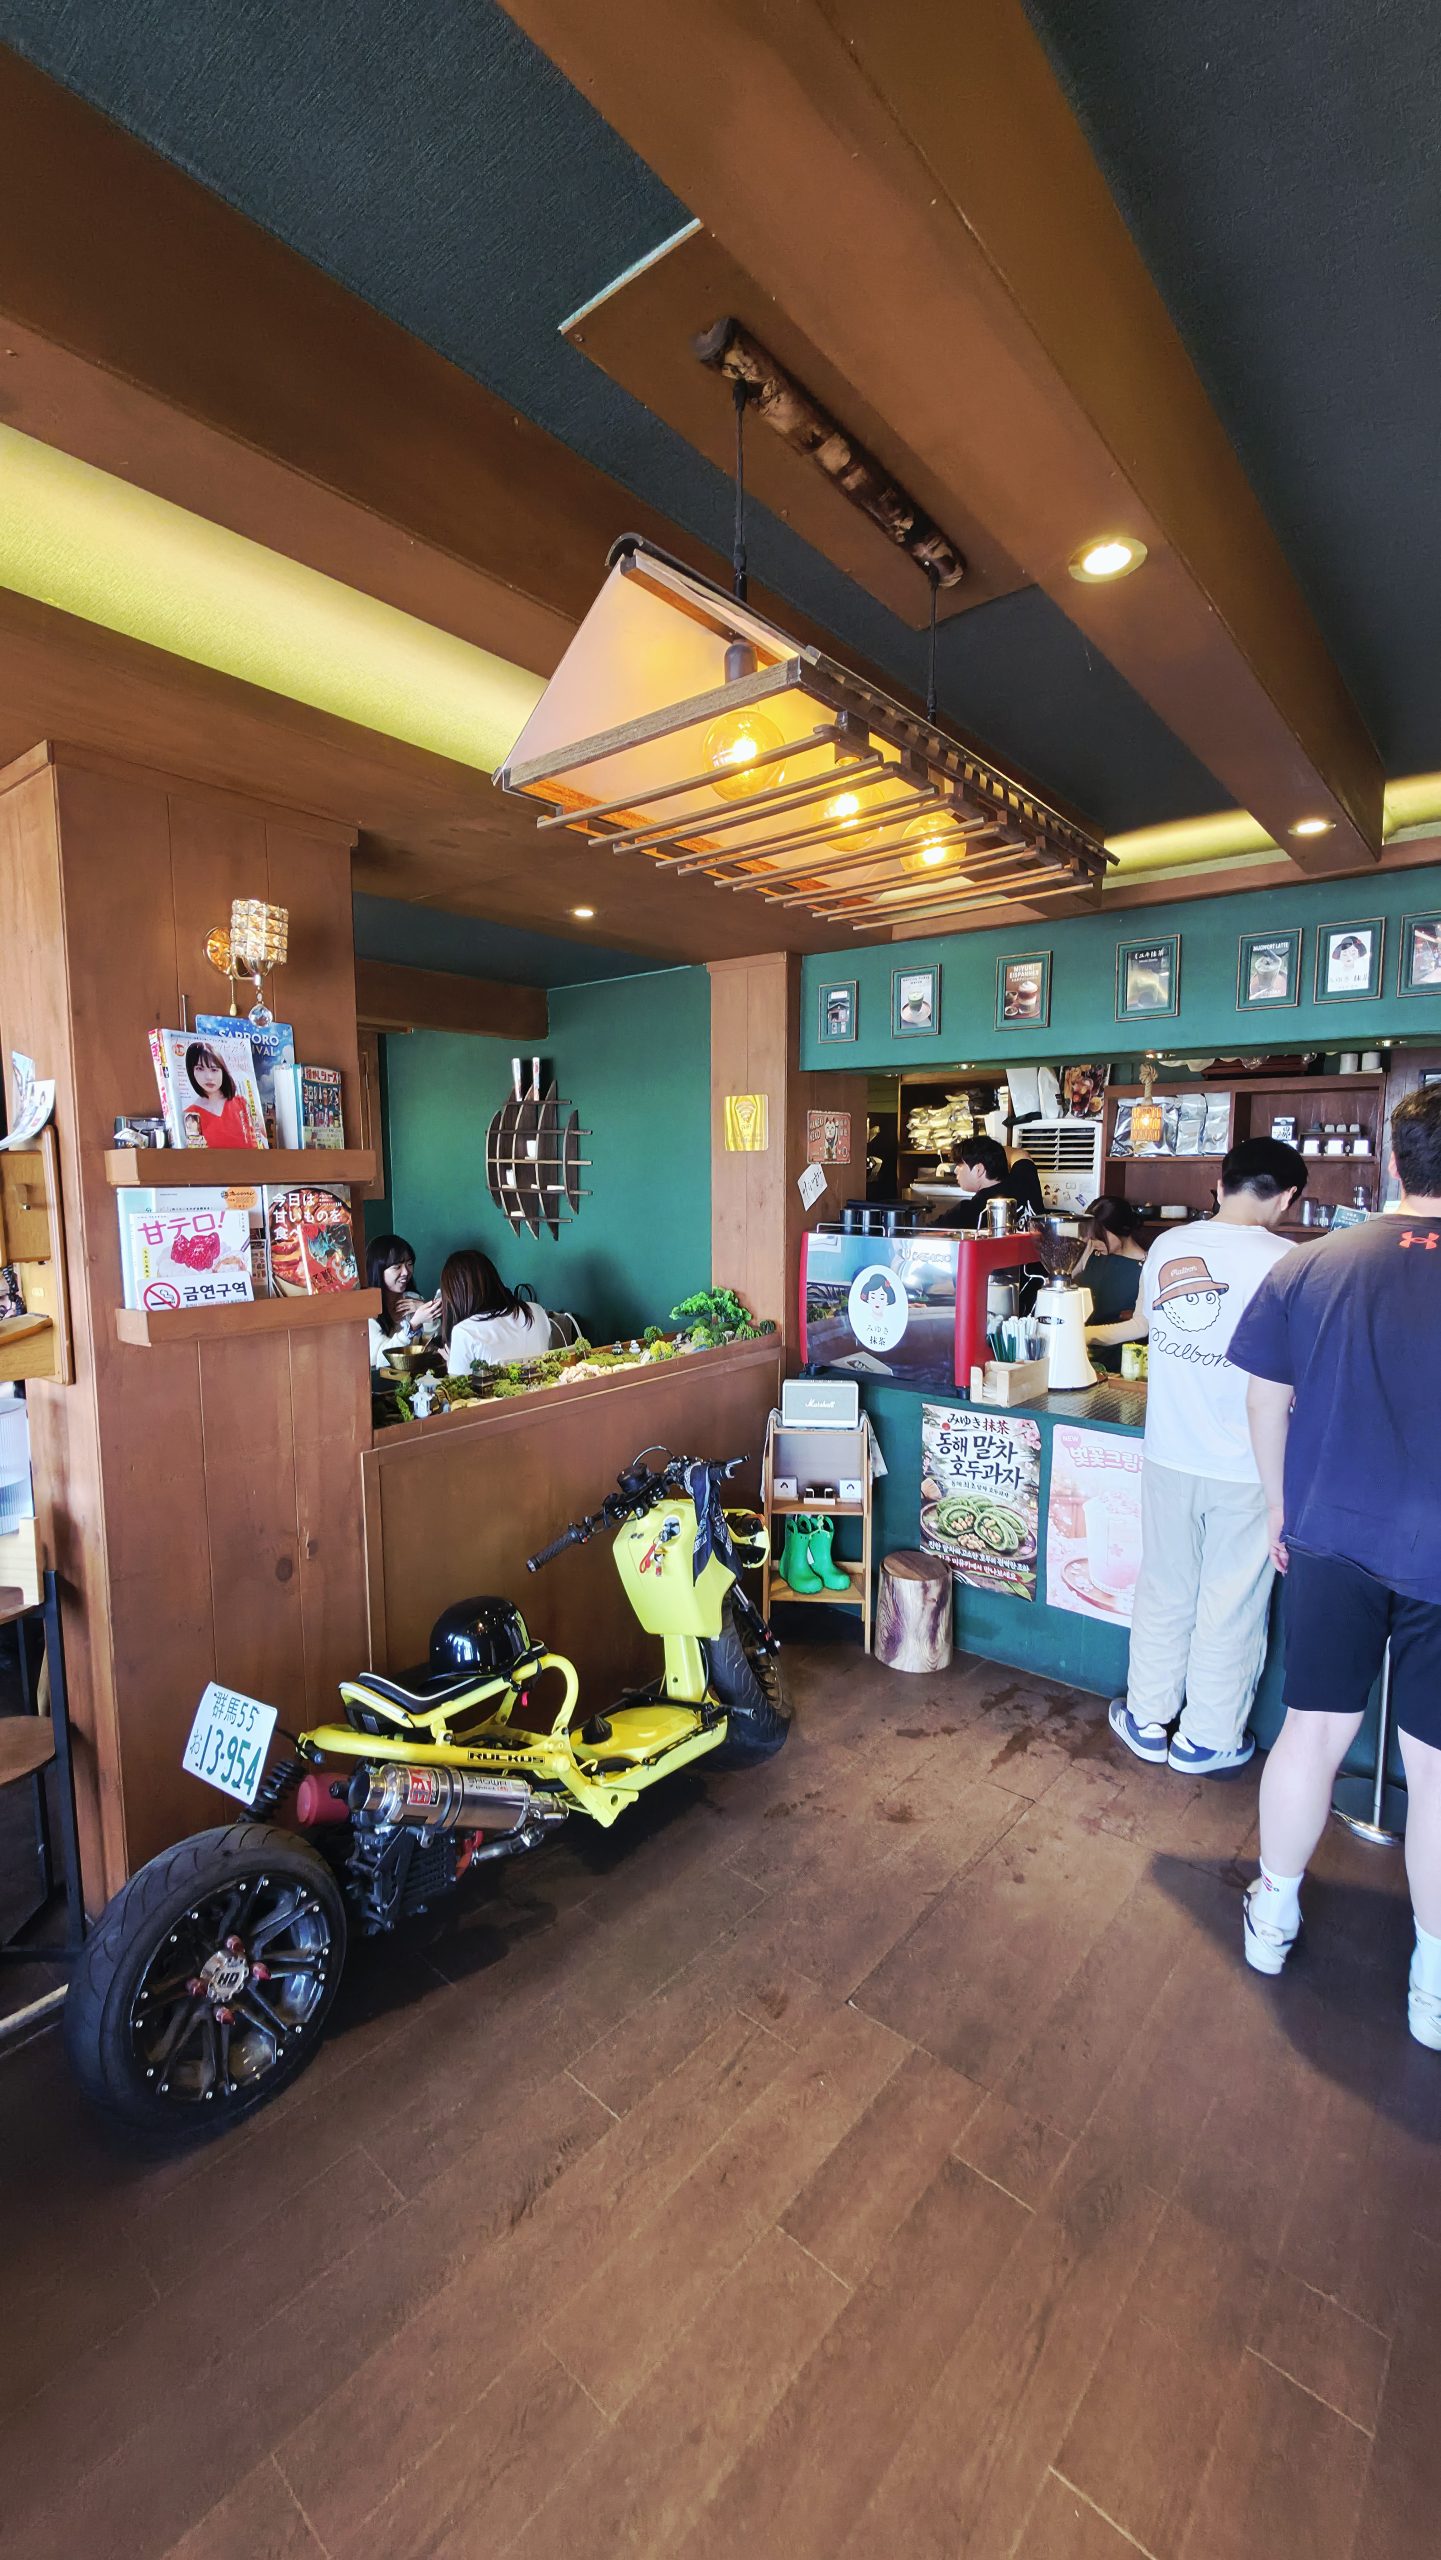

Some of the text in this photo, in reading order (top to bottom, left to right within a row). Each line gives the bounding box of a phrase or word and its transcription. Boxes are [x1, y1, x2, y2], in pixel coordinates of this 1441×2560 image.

[1275, 941, 1289, 949] LATTE
[272, 1192, 315, 1207] 今日は
[272, 1208, 341, 1224] 甘いものを
[183, 1281, 248, 1302] 금연구역
[866, 1324, 889, 1336] みゆき
[869, 1335, 886, 1346] 抹茶
[805, 1397, 836, 1409] Marshall
[947, 1412, 1011, 1436] みゆき抹茶
[936, 1431, 1018, 1465] 동해 말차
[949, 1454, 1025, 1491] 호두과자
[928, 1540, 941, 1551] 진한
[960, 1549, 978, 1560] 고소한
[951, 1558, 982, 1572] 미유키에서
[983, 1565, 1018, 1581] 만나보세요
[468, 1751, 545, 1764] RUCKUS
